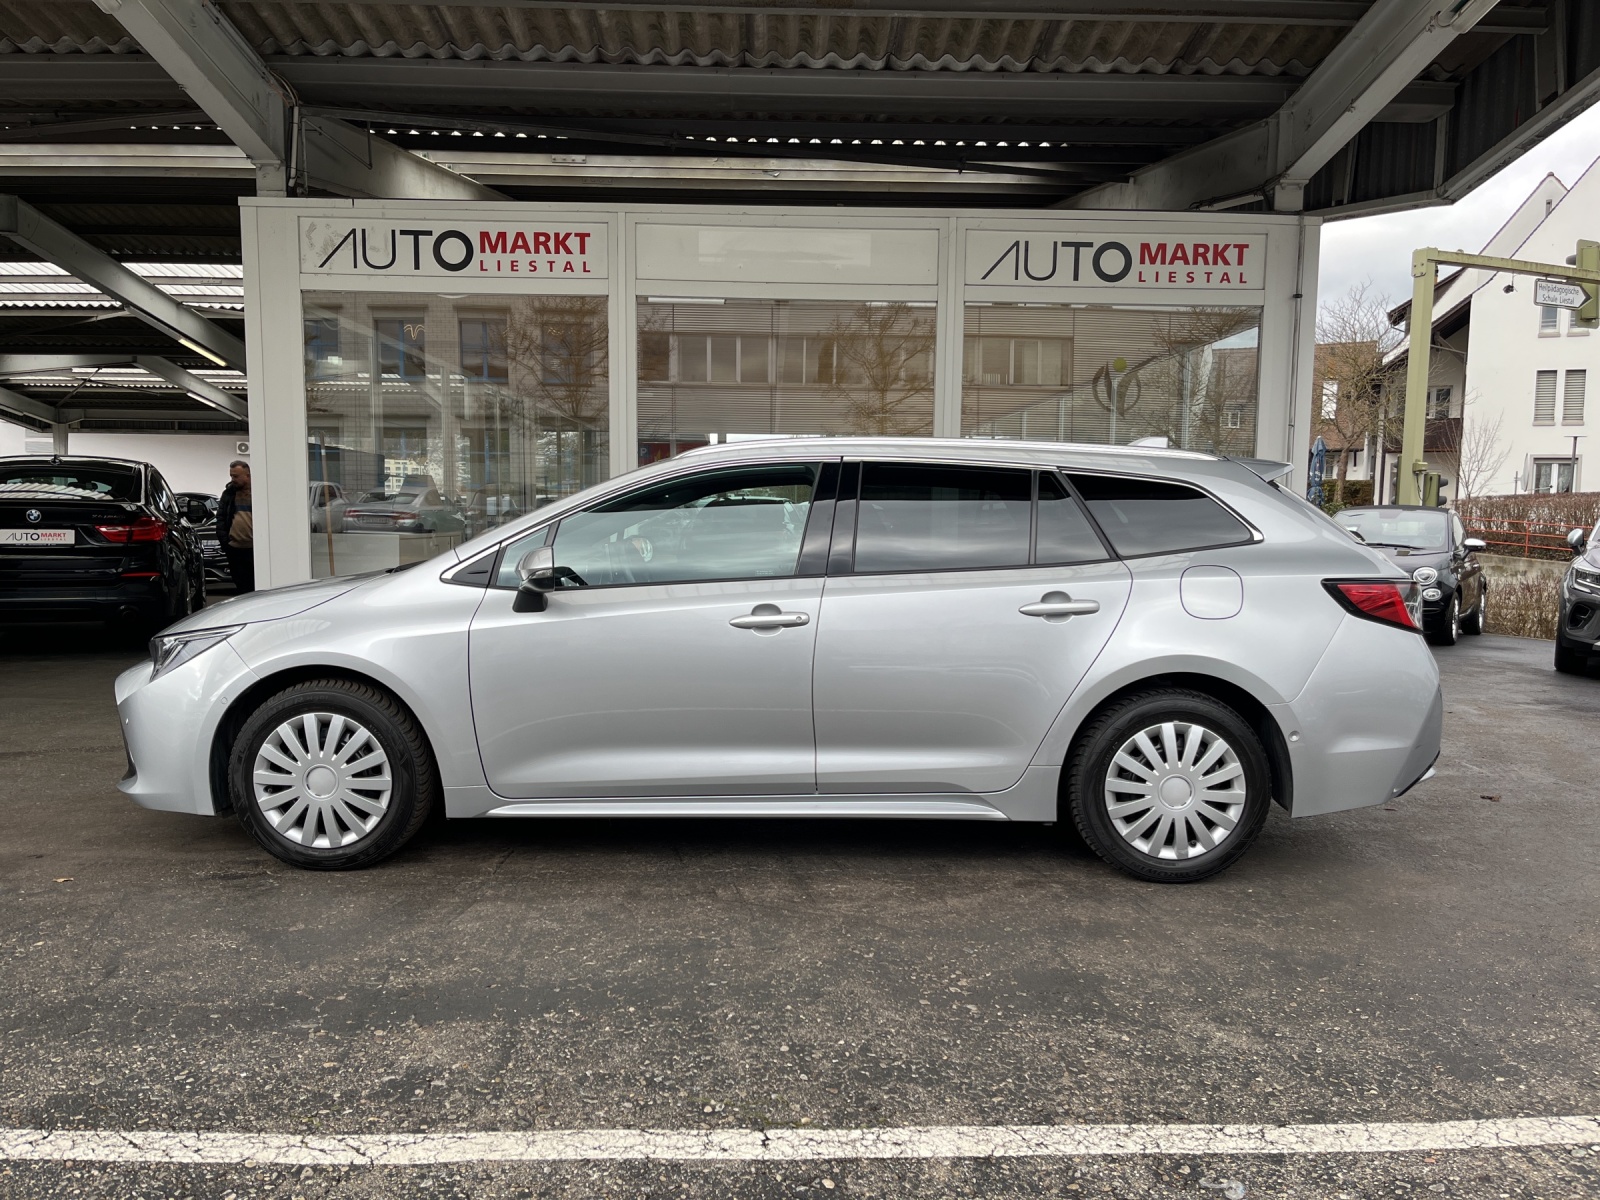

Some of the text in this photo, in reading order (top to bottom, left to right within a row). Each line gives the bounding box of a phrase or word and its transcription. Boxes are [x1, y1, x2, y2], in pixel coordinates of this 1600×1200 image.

[318, 228, 591, 272] AUTO MARKT
[479, 259, 591, 273] LIESTAL
[980, 240, 1250, 283] AUTO MARKT
[1138, 271, 1248, 284] LIESTAL
[1538, 283, 1580, 296] Heilpädagogische
[1542, 294, 1574, 305] Schule Liestal
[5, 532, 40, 541] AUTO
